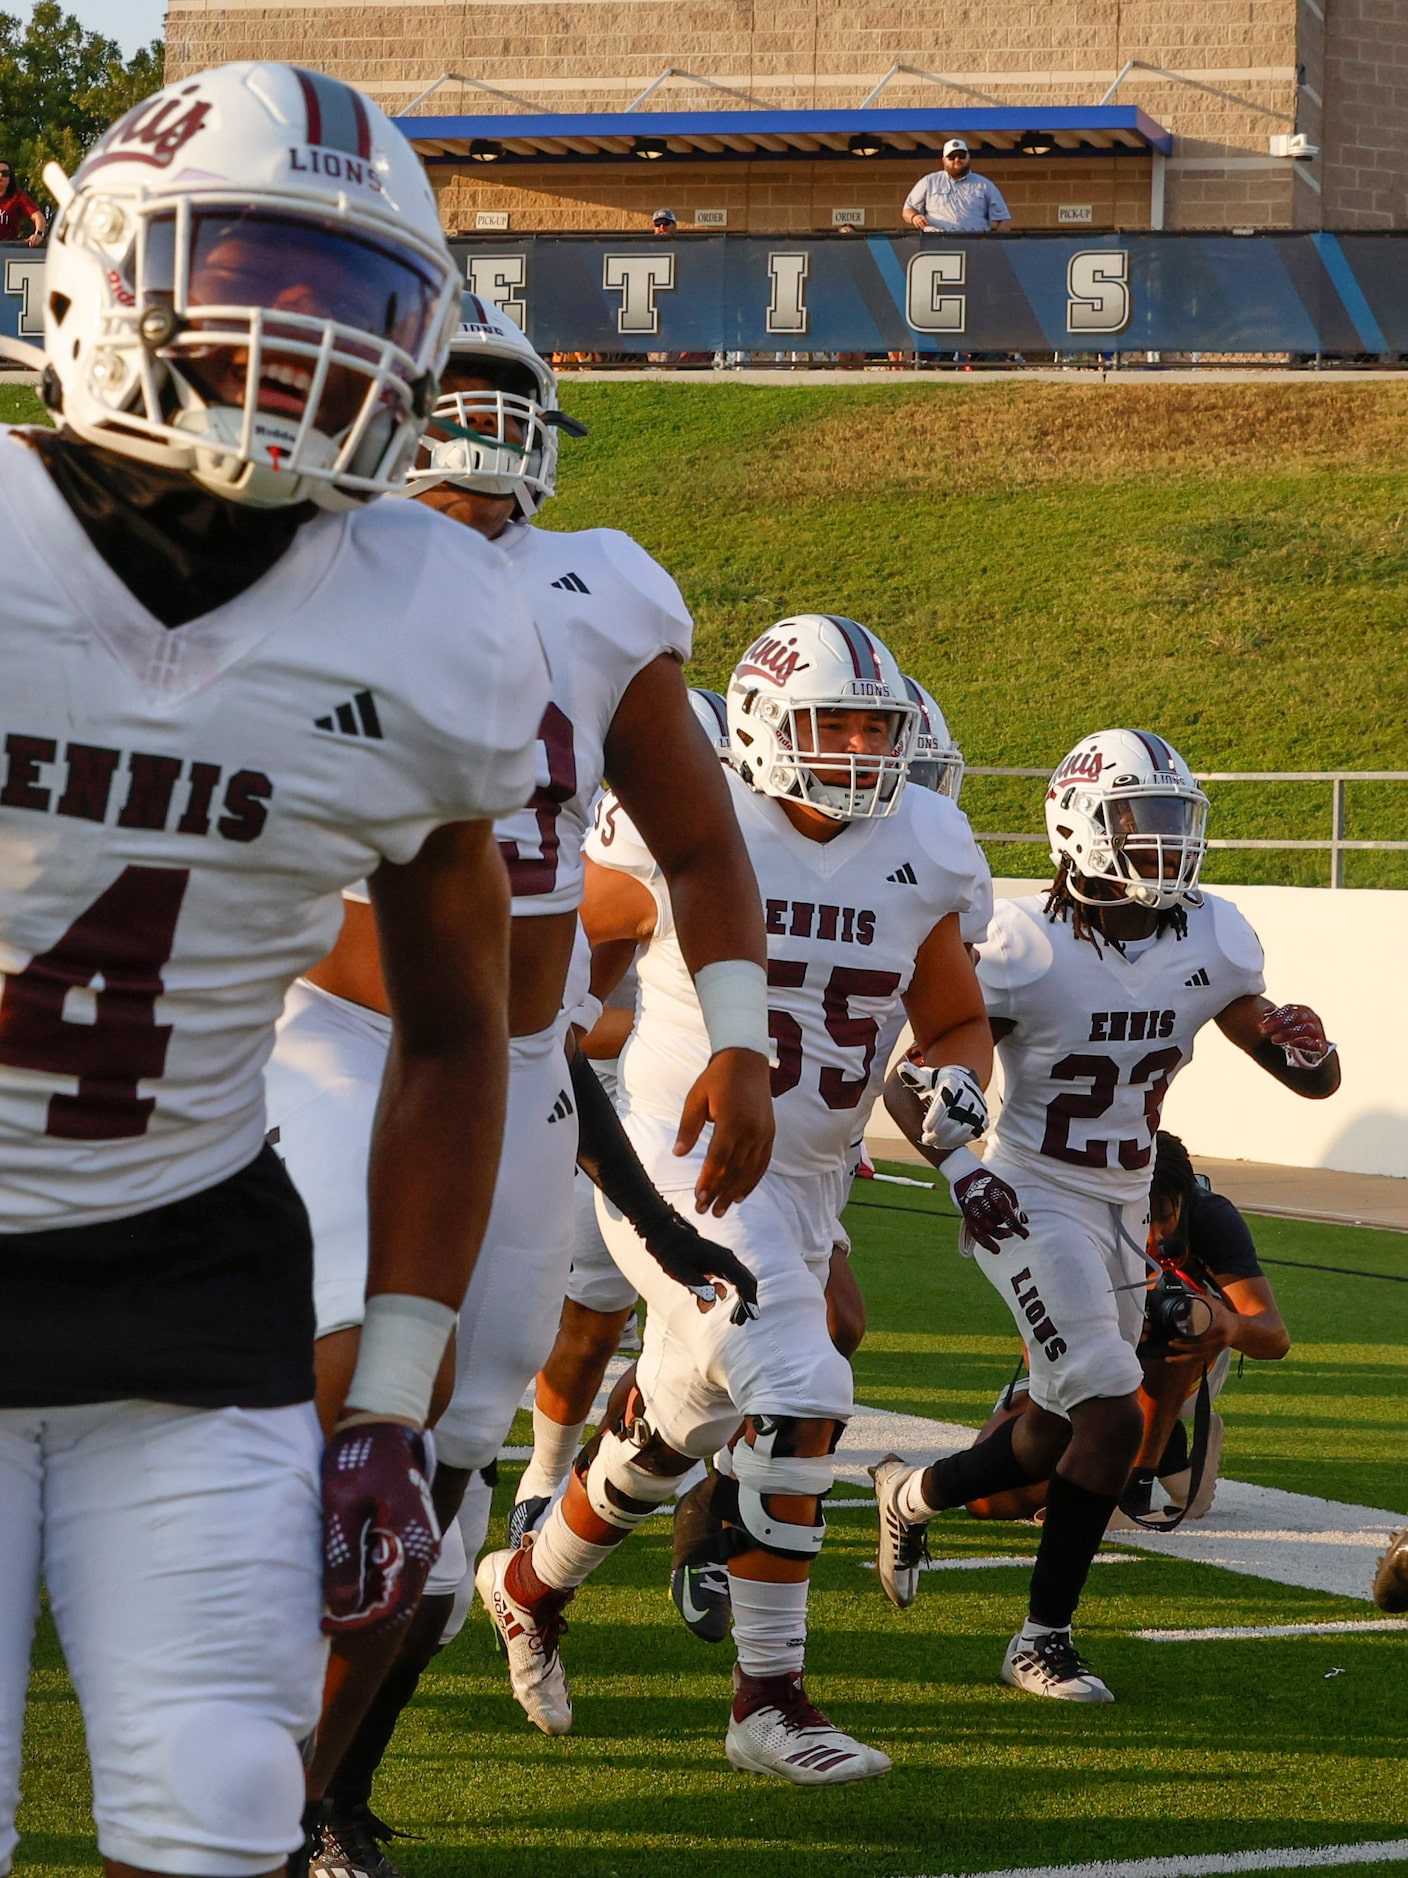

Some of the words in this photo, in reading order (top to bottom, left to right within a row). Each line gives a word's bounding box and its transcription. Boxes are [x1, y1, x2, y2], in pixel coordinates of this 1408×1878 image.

[287, 147, 382, 194] LIONS
[477, 215, 508, 226] PICK-UP
[698, 212, 724, 223] ORDER
[835, 211, 862, 222] ORDER
[1059, 208, 1091, 219] PICK-UP
[851, 682, 890, 698] LIONS
[917, 736, 939, 750] ONS
[0, 732, 274, 844] ENNIS
[1153, 774, 1185, 786] LIONS
[766, 898, 877, 946] ENNIS
[1088, 1008, 1177, 1042] ENNIS
[1040, 1044, 1184, 1171] 23
[1010, 1266, 1068, 1364] LIONS
